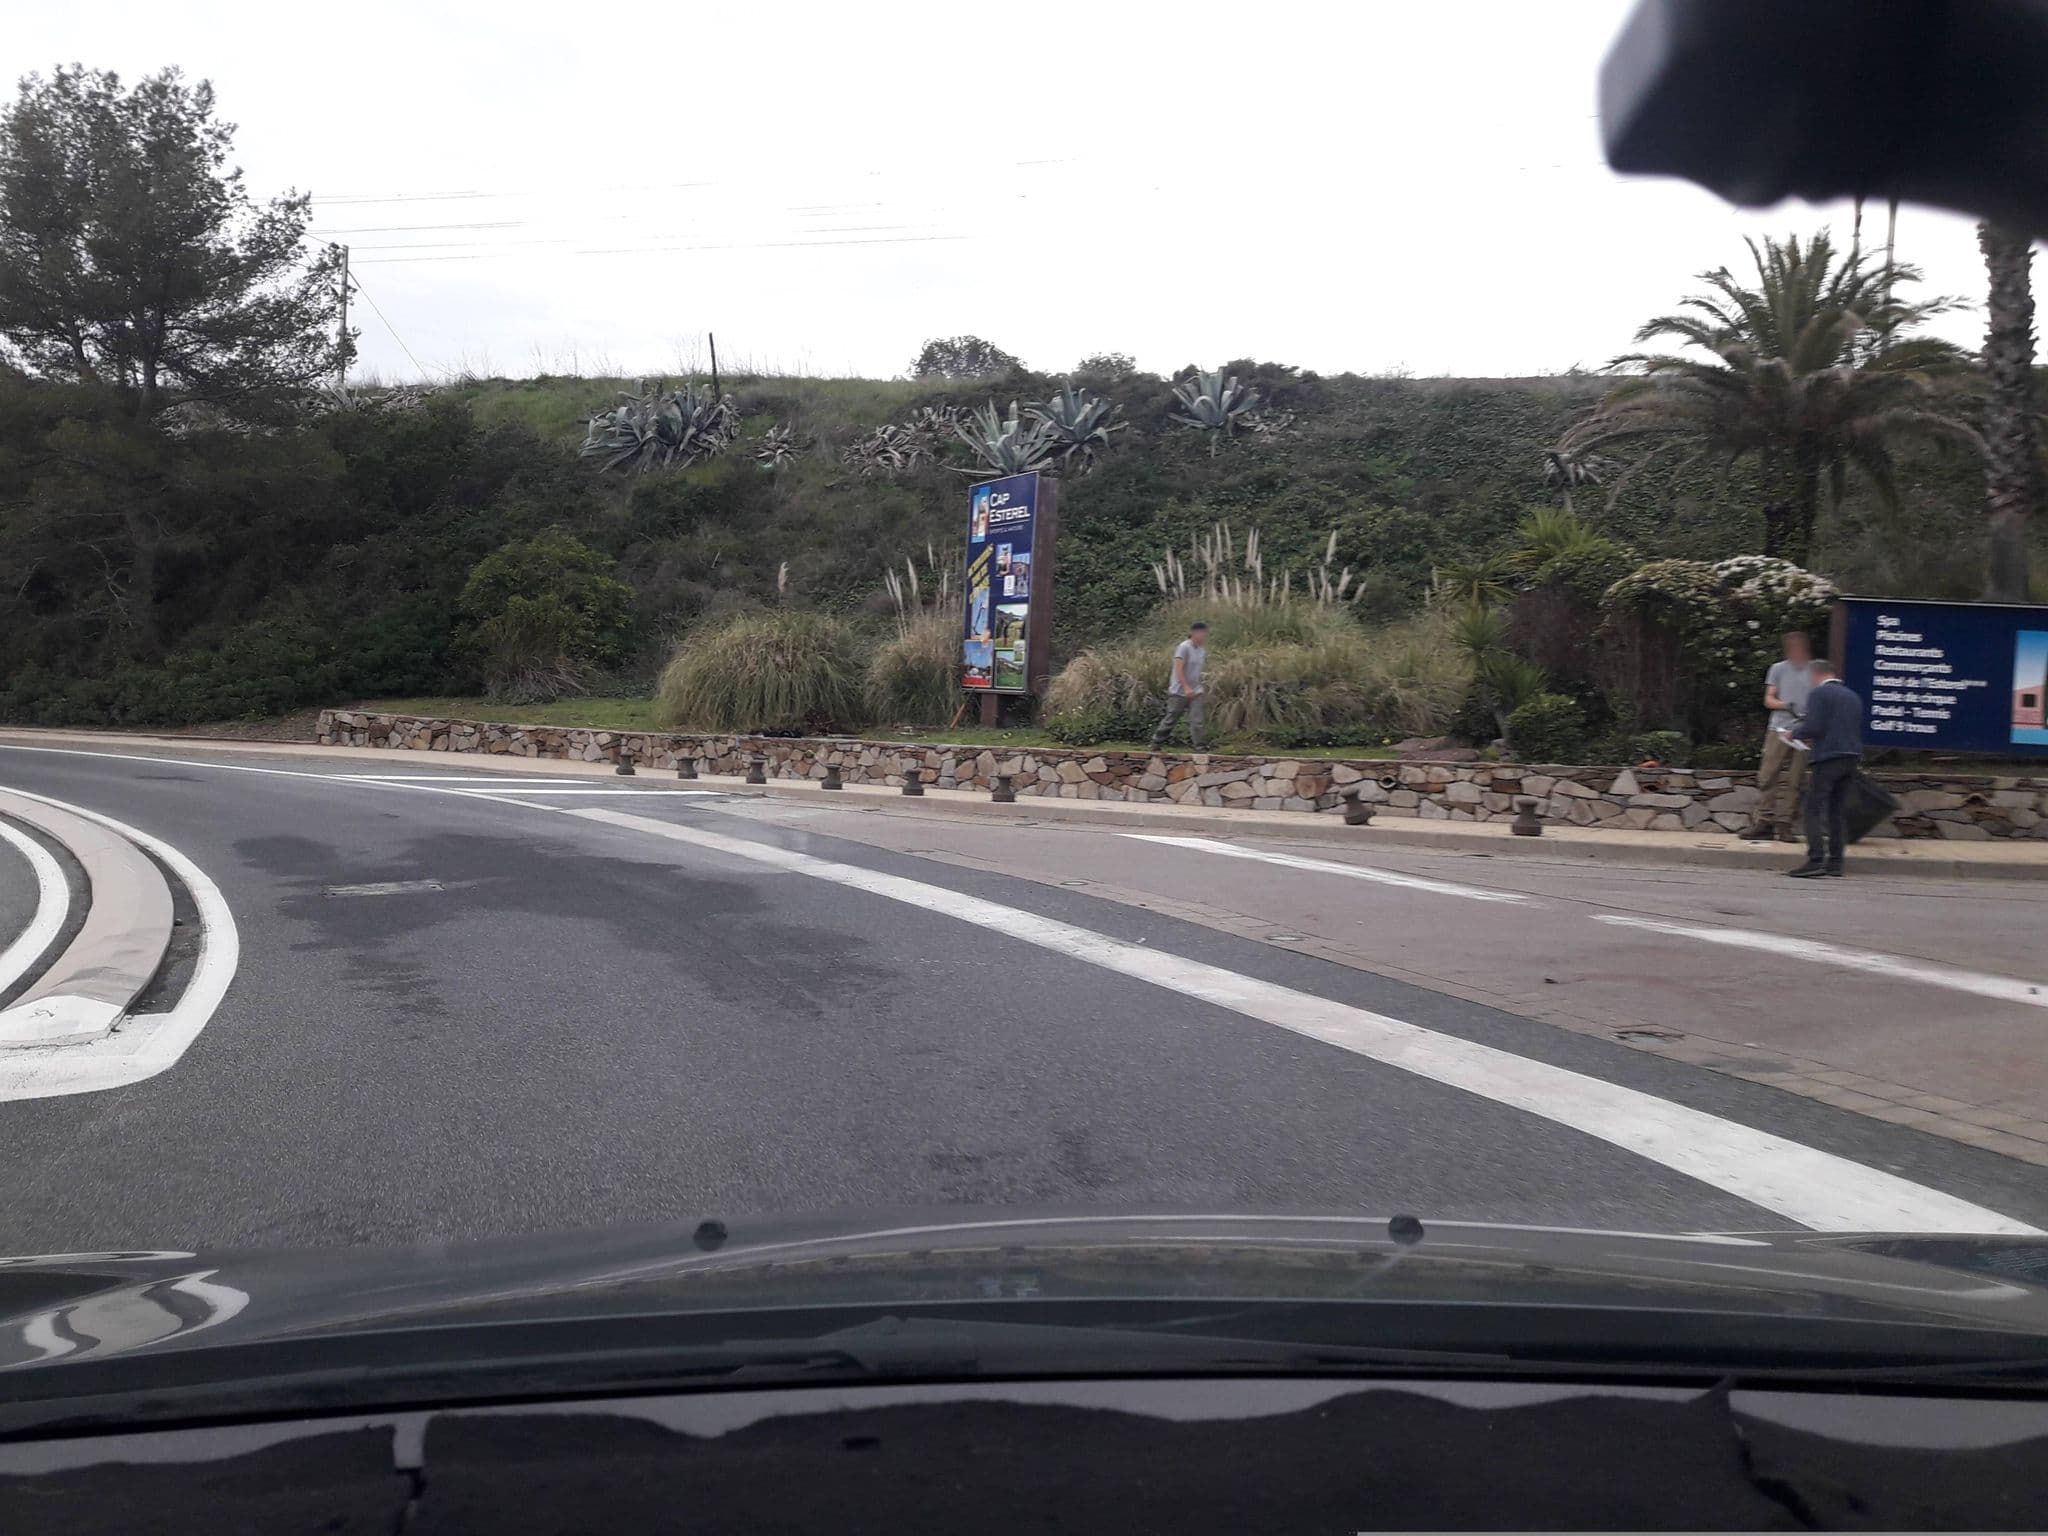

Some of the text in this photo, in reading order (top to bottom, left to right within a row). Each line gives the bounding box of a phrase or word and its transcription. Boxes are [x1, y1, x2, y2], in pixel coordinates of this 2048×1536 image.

[990, 493, 1010, 506] CAP
[1876, 615, 1900, 628] Spa
[1874, 645, 1945, 658] Restaurants
[1912, 707, 1951, 719] Tennis
[1870, 720, 1896, 731] Golf
